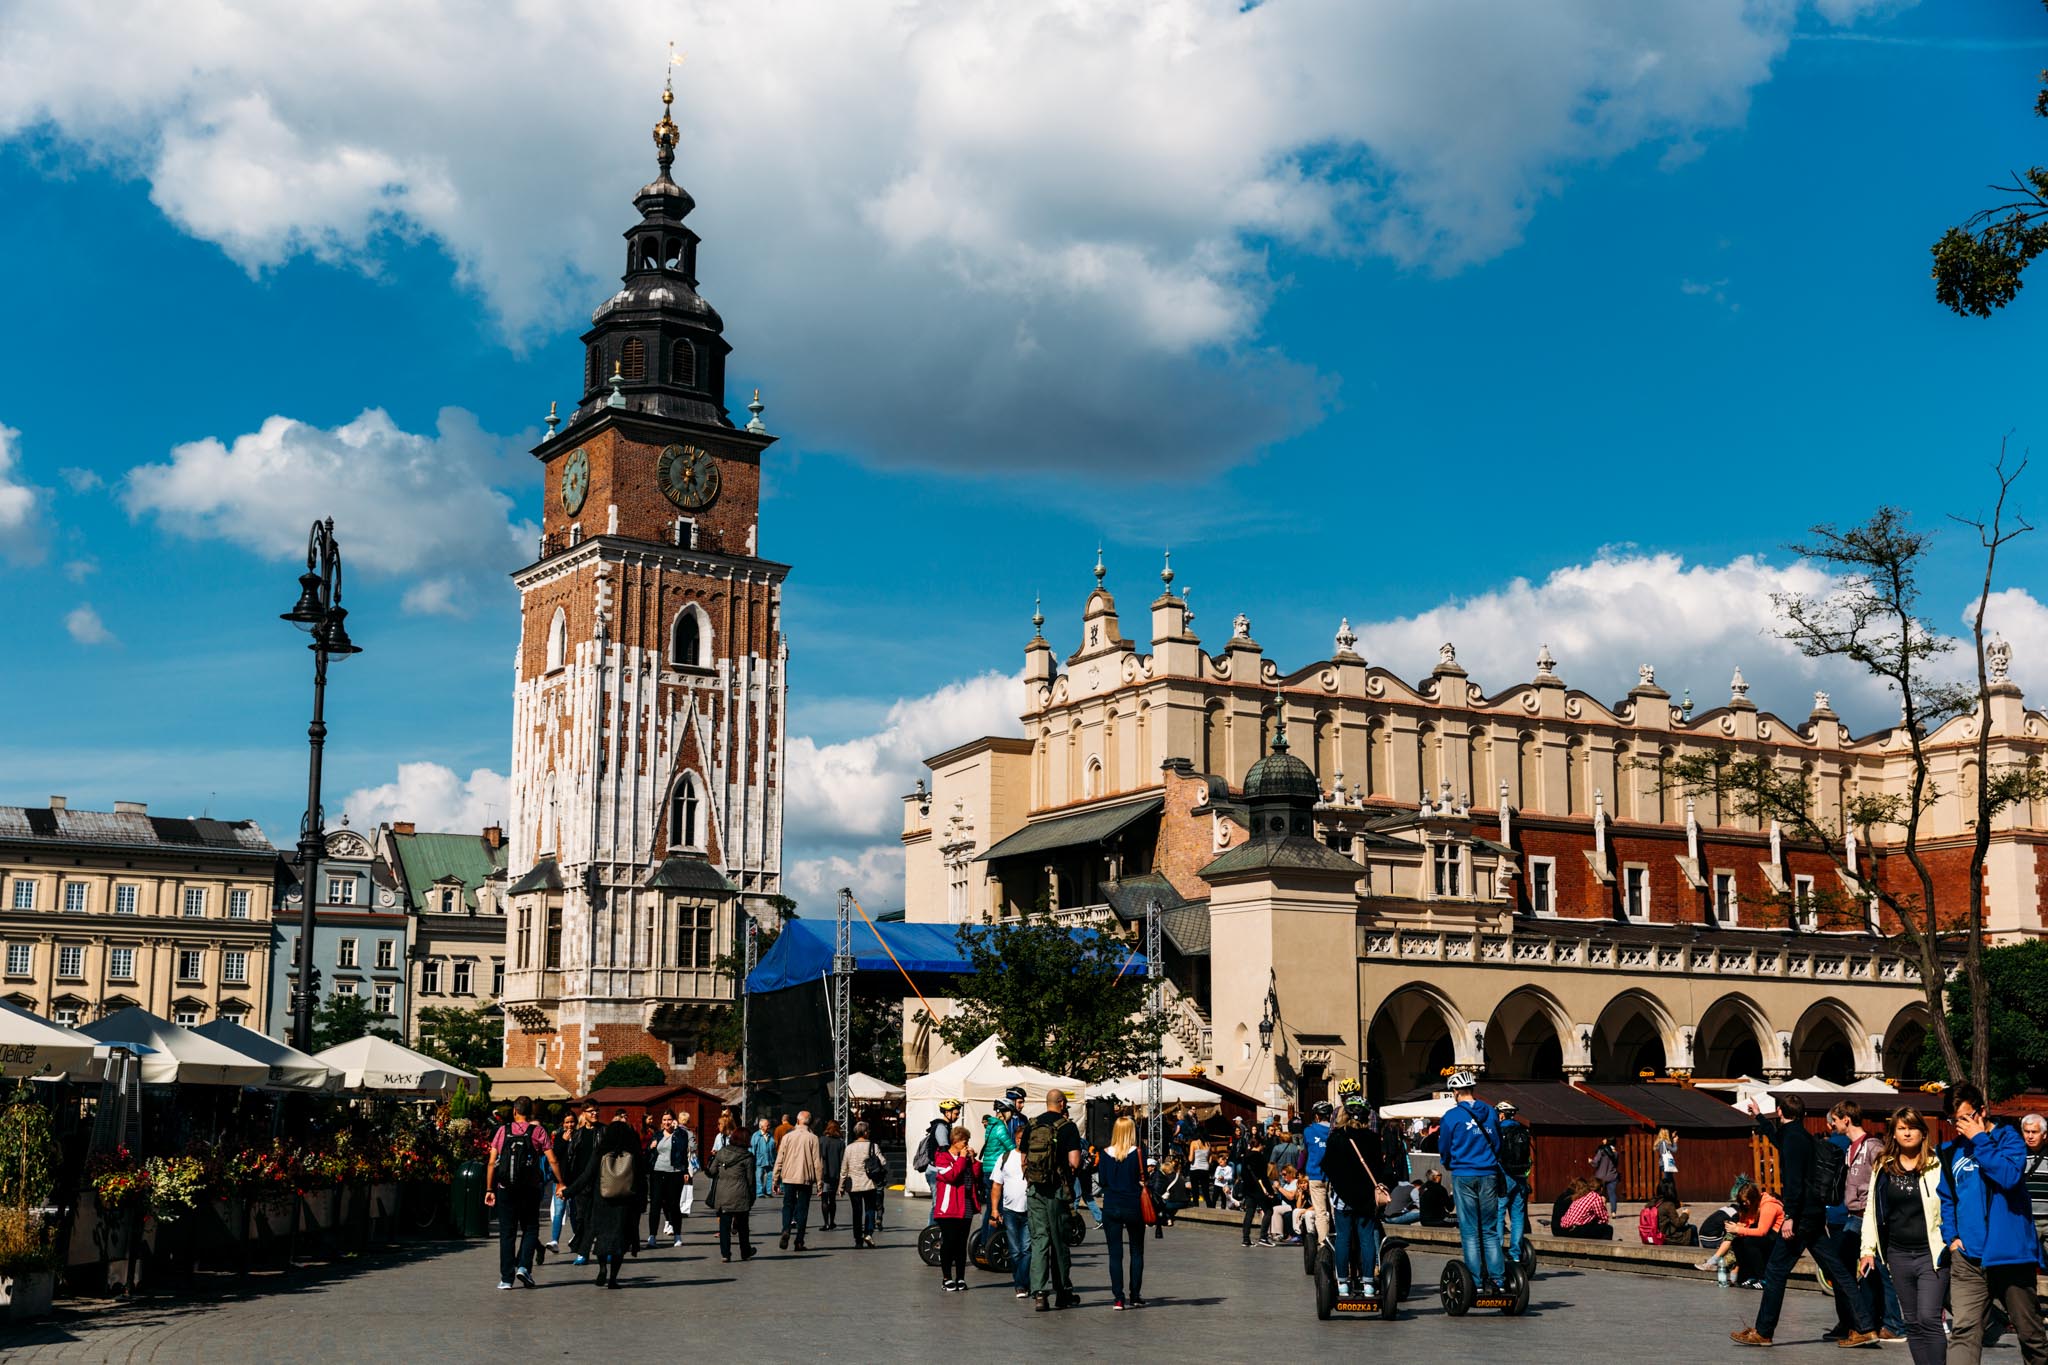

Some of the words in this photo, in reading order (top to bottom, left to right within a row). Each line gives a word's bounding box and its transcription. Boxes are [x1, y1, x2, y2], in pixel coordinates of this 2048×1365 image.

[383, 1073, 412, 1084] MAX
[1337, 1303, 1372, 1311] GRODZKA
[1475, 1299, 1507, 1307] GRODZKA
